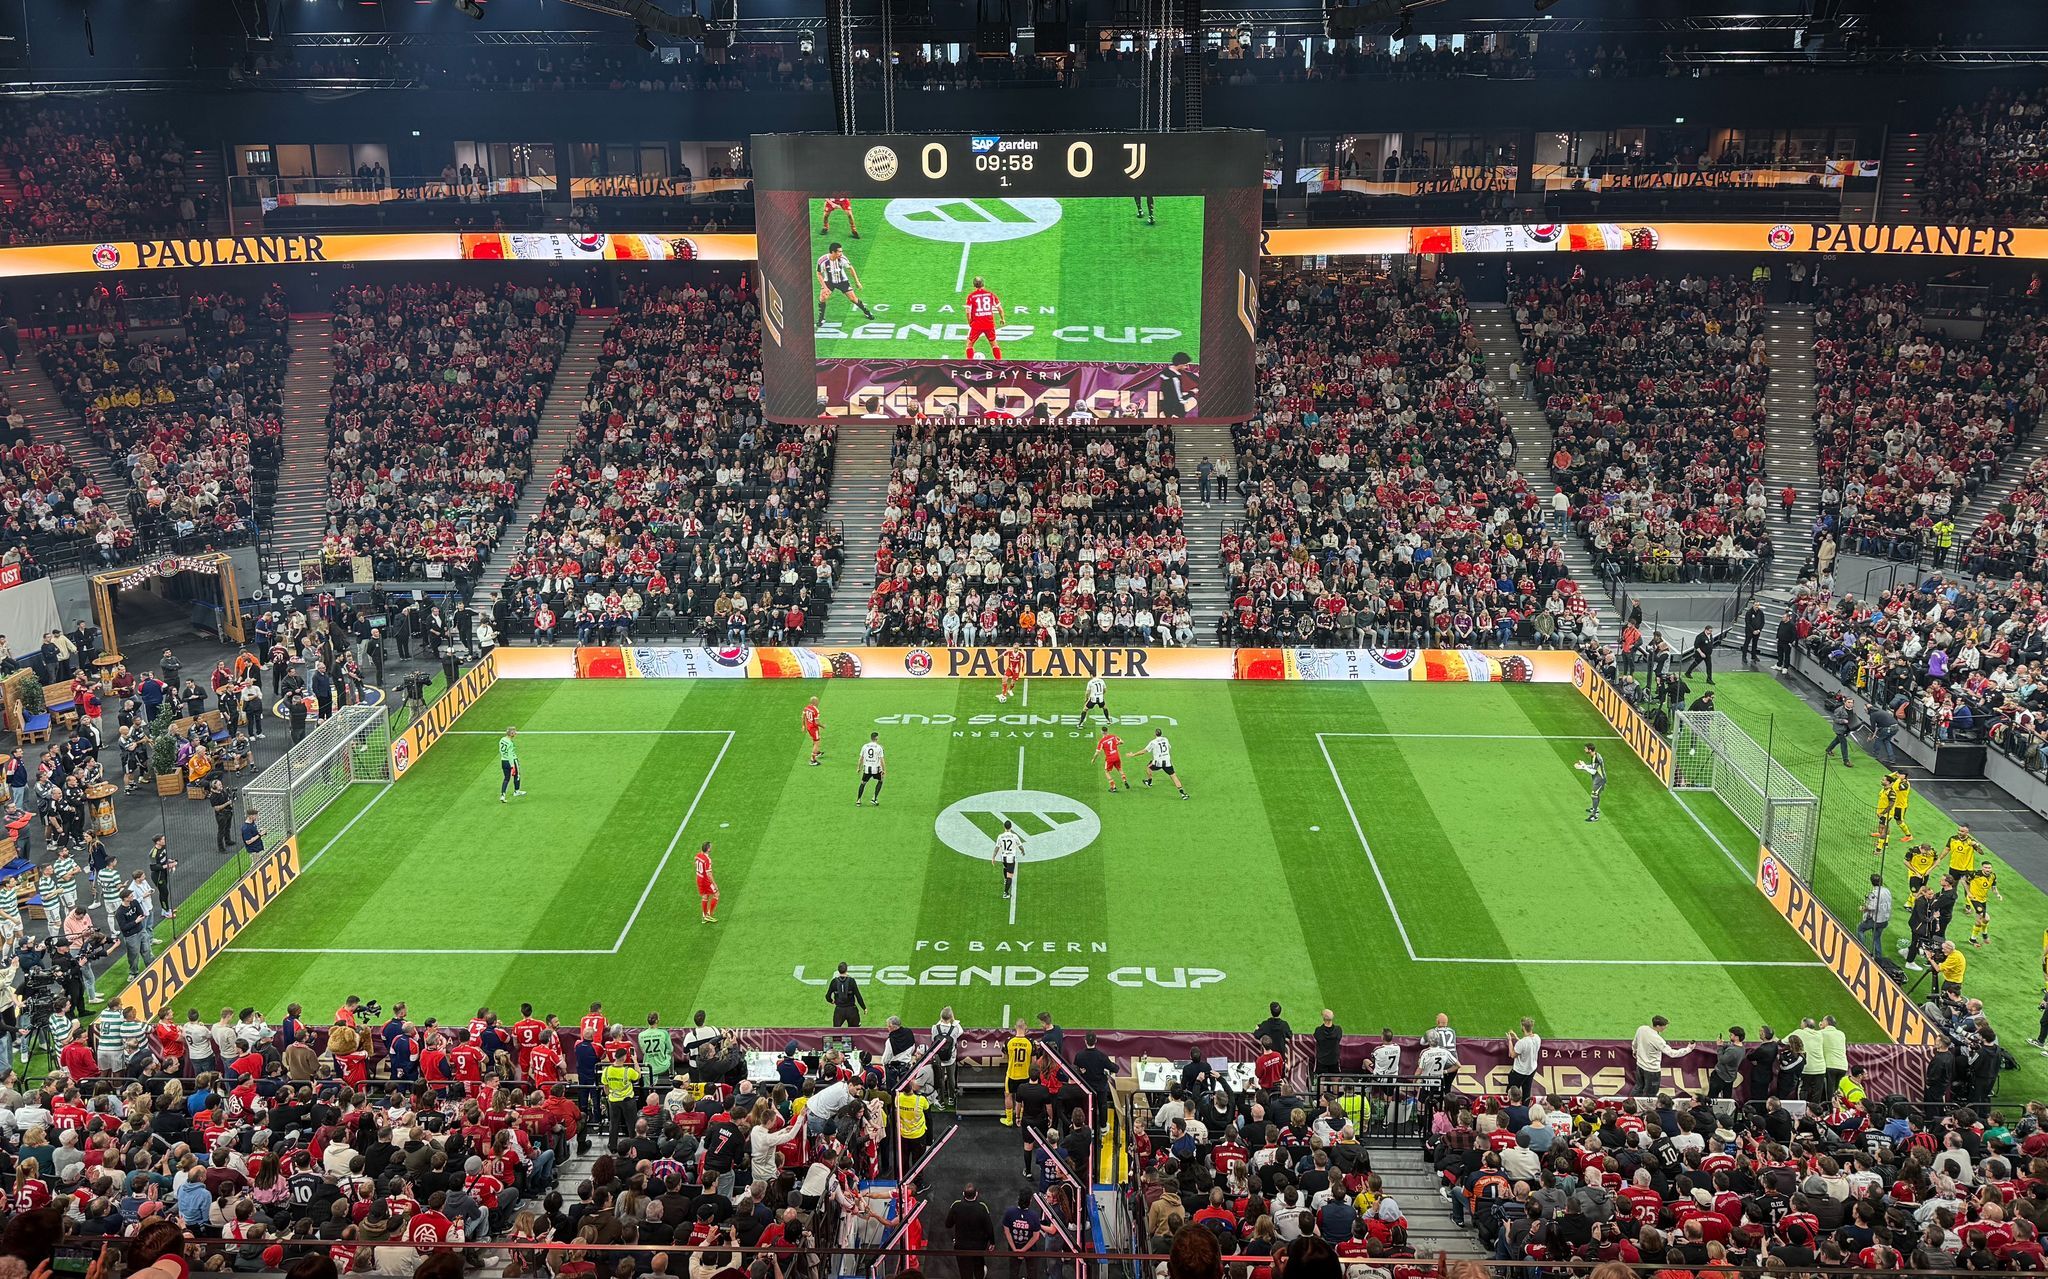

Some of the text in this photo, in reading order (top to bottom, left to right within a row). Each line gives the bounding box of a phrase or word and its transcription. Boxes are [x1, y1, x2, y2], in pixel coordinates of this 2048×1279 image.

[972, 138, 1038, 152] SAP garden
[921, 142, 948, 179] 0
[975, 155, 1034, 172] 09:58
[1066, 141, 1093, 178] 0
[1000, 175, 1012, 187] 1.
[1809, 225, 2015, 256] PAULANER
[133, 234, 326, 268] PAULANER
[974, 297, 992, 312] 18
[951, 370, 1063, 382] FC BAYERN
[915, 417, 1100, 426] MAKING HISTORY PRESENT
[1346, 651, 1356, 662] ER
[1349, 665, 1359, 679] HE
[1095, 682, 1103, 693] 11
[414, 652, 496, 755] PAULANER
[873, 713, 957, 725] CUP
[1589, 669, 1668, 784] PAULANER
[867, 748, 875, 759] 9
[1158, 742, 1168, 753] 13
[1002, 839, 1012, 852] 12
[138, 847, 298, 1022] PAULANER
[916, 941, 1107, 952] FC BAYERN
[793, 965, 1227, 988] LEGENDS CUP
[584, 1019, 597, 1032] 11
[524, 1030, 532, 1043] 9
[1439, 1031, 1455, 1047] 12
[644, 1039, 660, 1053] 22
[457, 1055, 465, 1069] 9
[1014, 1048, 1025, 1062] 10
[1542, 1050, 1616, 1060] BAYERN
[1388, 1056, 1396, 1070] 7
[1434, 1057, 1441, 1071] 3
[714, 1135, 729, 1154] 7
[1662, 1148, 1678, 1166] 10
[294, 1186, 312, 1204] 10
